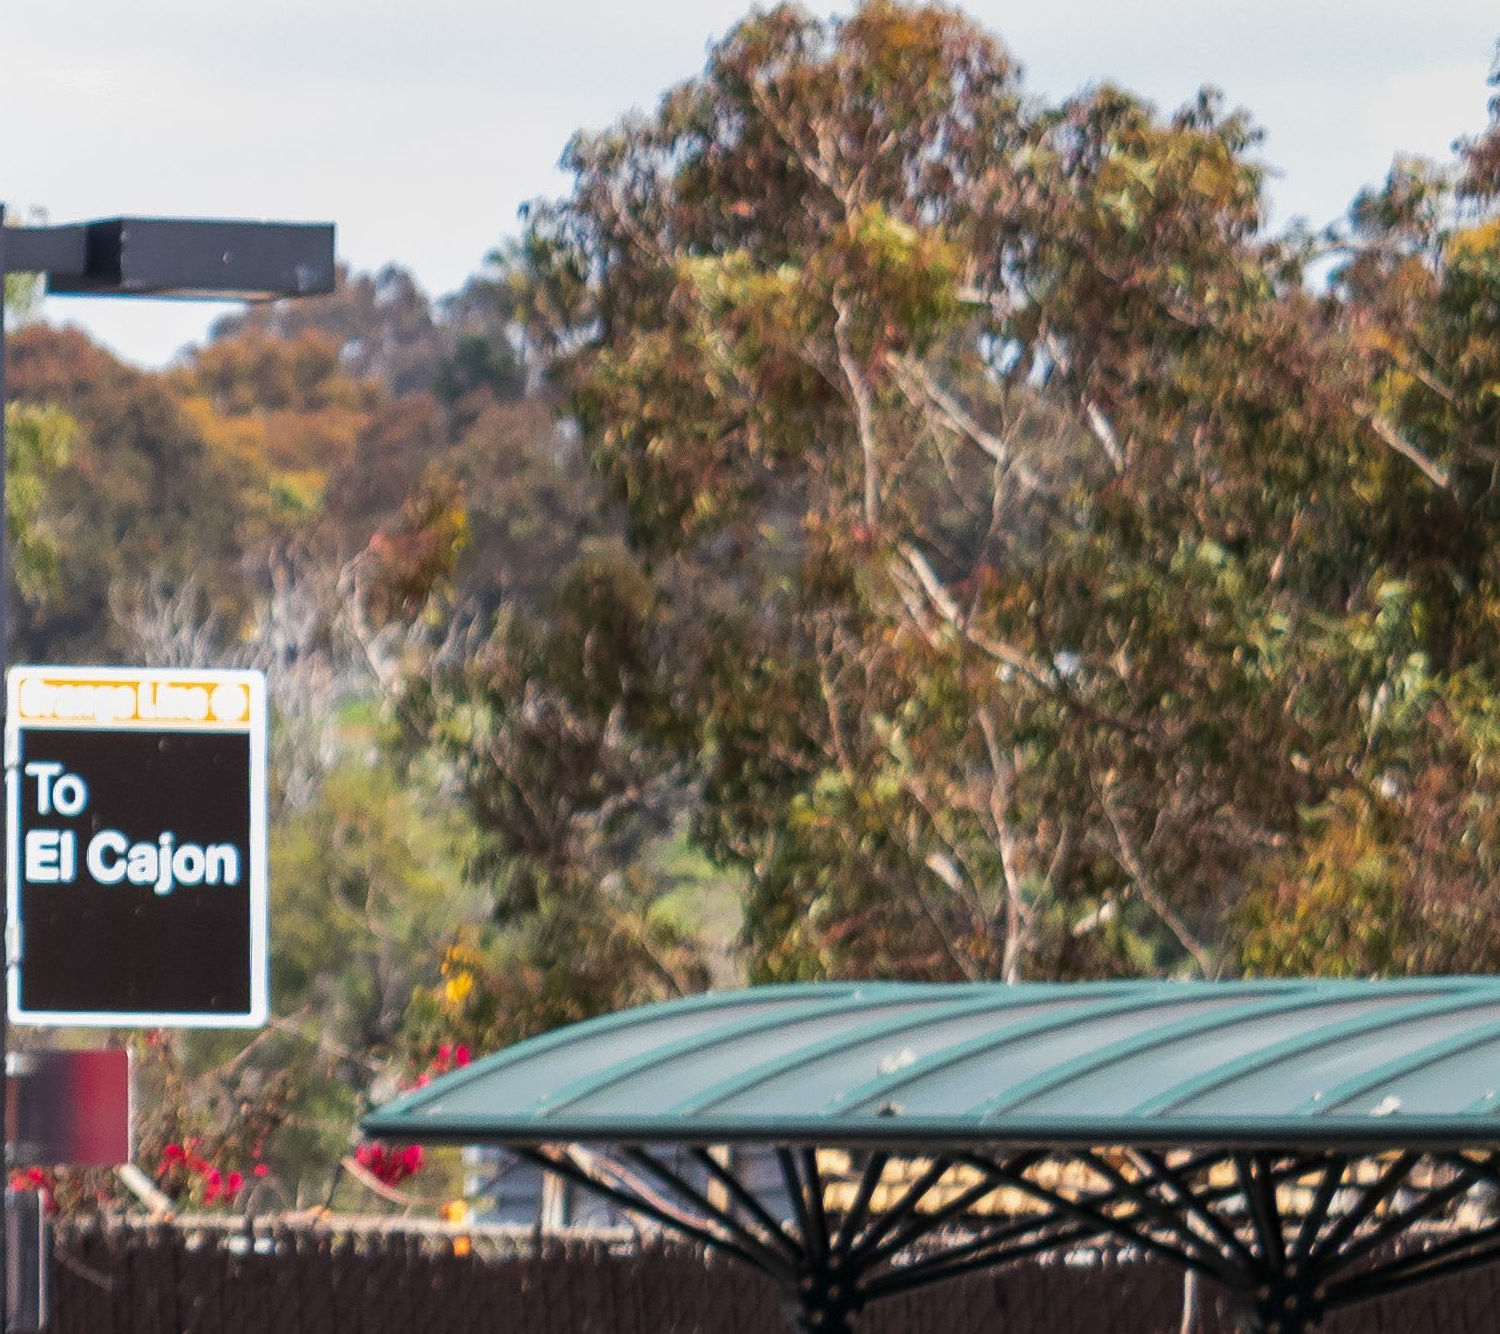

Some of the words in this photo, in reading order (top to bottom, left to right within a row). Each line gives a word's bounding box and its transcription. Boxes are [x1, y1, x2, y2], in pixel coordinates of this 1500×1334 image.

[25, 760, 89, 816] To
[24, 828, 76, 884] El
[86, 828, 241, 895] Cajon
